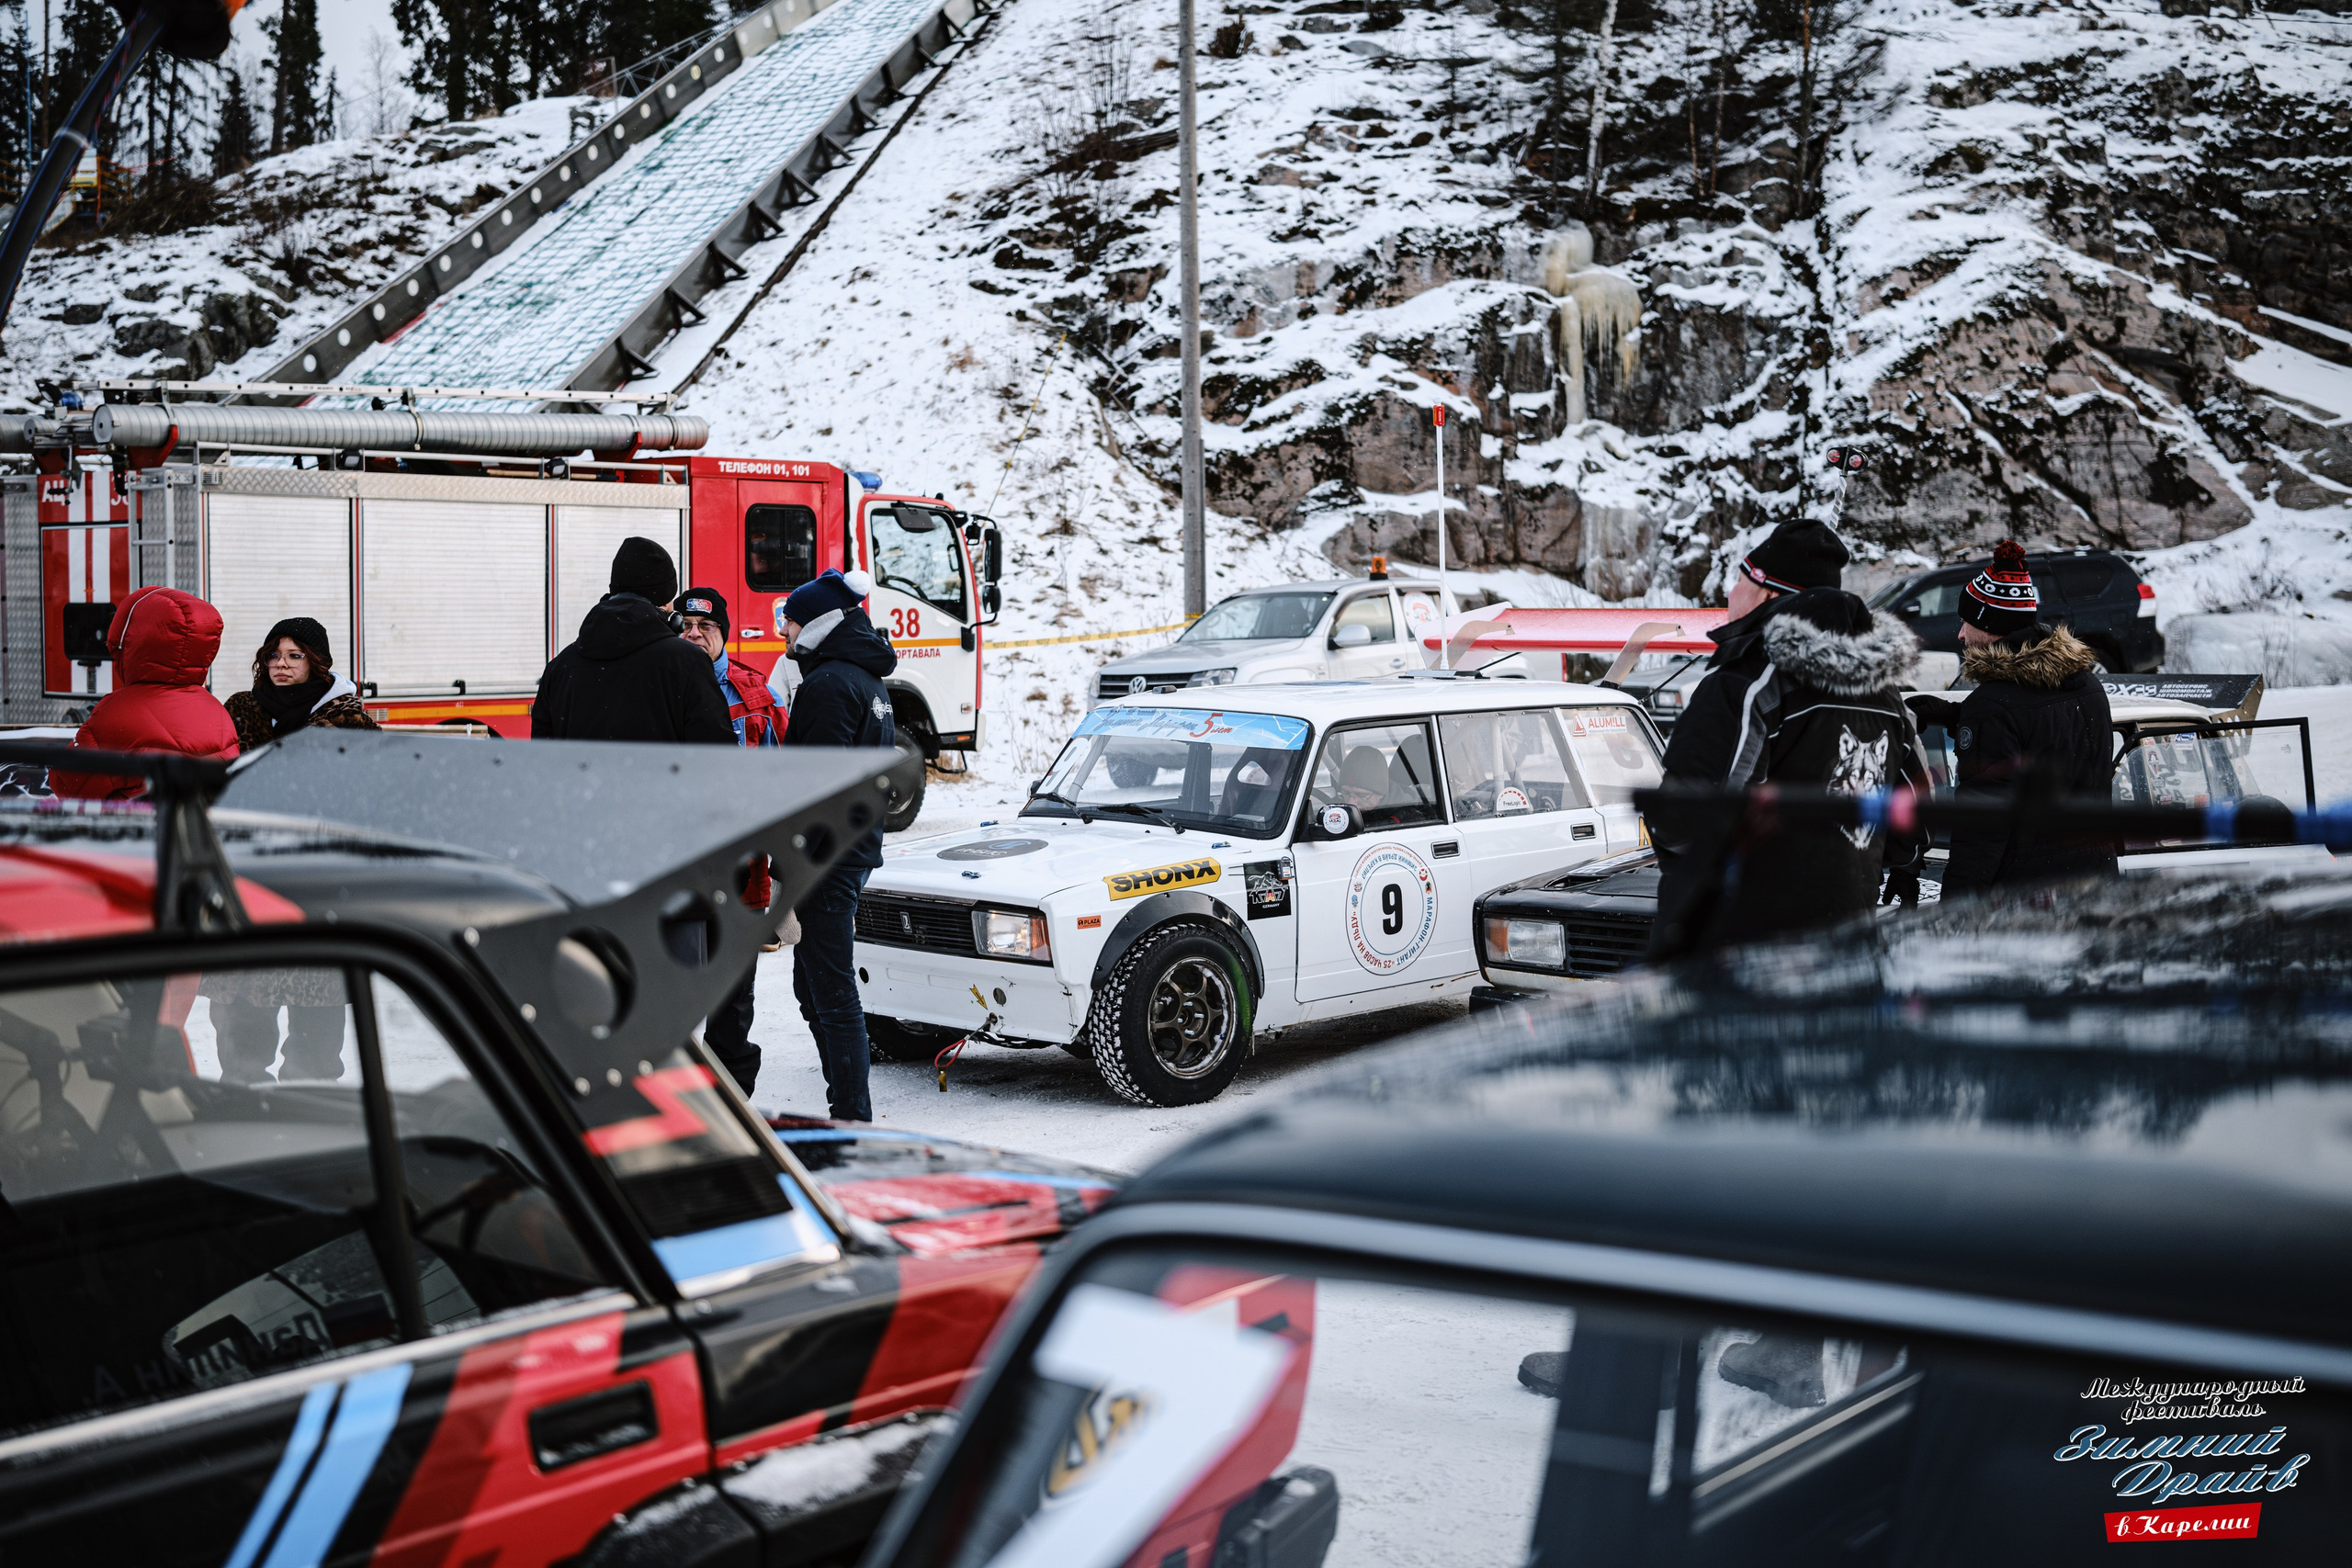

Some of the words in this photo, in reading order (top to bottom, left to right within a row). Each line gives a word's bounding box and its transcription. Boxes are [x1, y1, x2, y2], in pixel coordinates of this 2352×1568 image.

[718, 461, 772, 475] ТЕЛЕФОН
[774, 464, 789, 478] 01,
[792, 465, 809, 477] 101
[890, 608, 921, 638] 38
[896, 649, 941, 659] ОРТАВАЛА
[1189, 712, 1223, 738] 5
[1111, 861, 1216, 892] SHONX
[1382, 883, 1403, 935] 9
[1357, 941, 1365, 953] НА
[1363, 951, 1382, 968] ЧАСОВ
